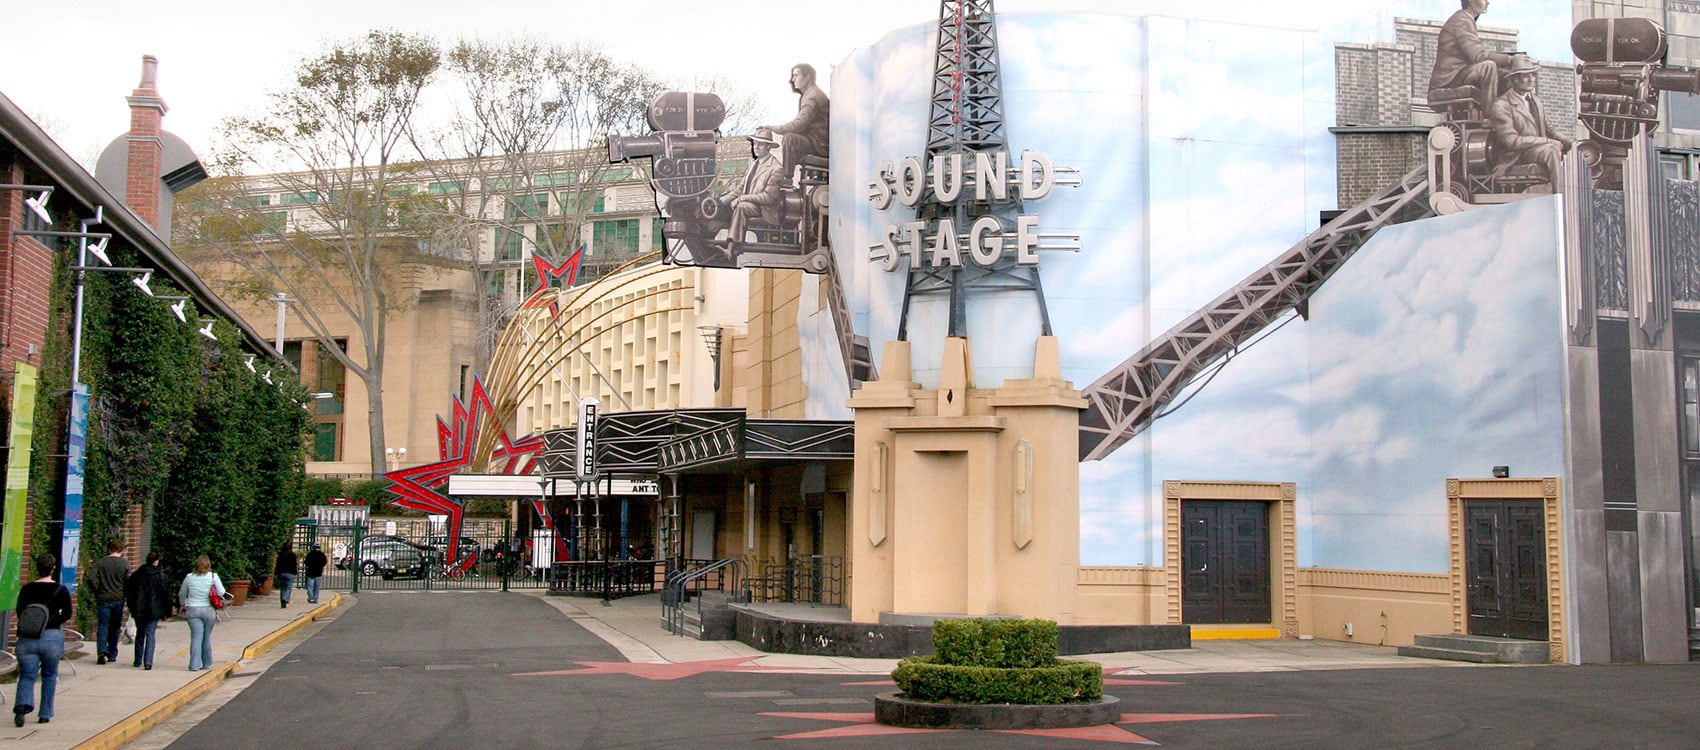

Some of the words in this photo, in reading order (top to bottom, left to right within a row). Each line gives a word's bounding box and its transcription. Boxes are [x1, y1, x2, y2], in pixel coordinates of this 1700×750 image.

[873, 151, 1055, 210] SOUND
[882, 214, 1040, 272] STAGE
[585, 406, 594, 474] ENTRANCE
